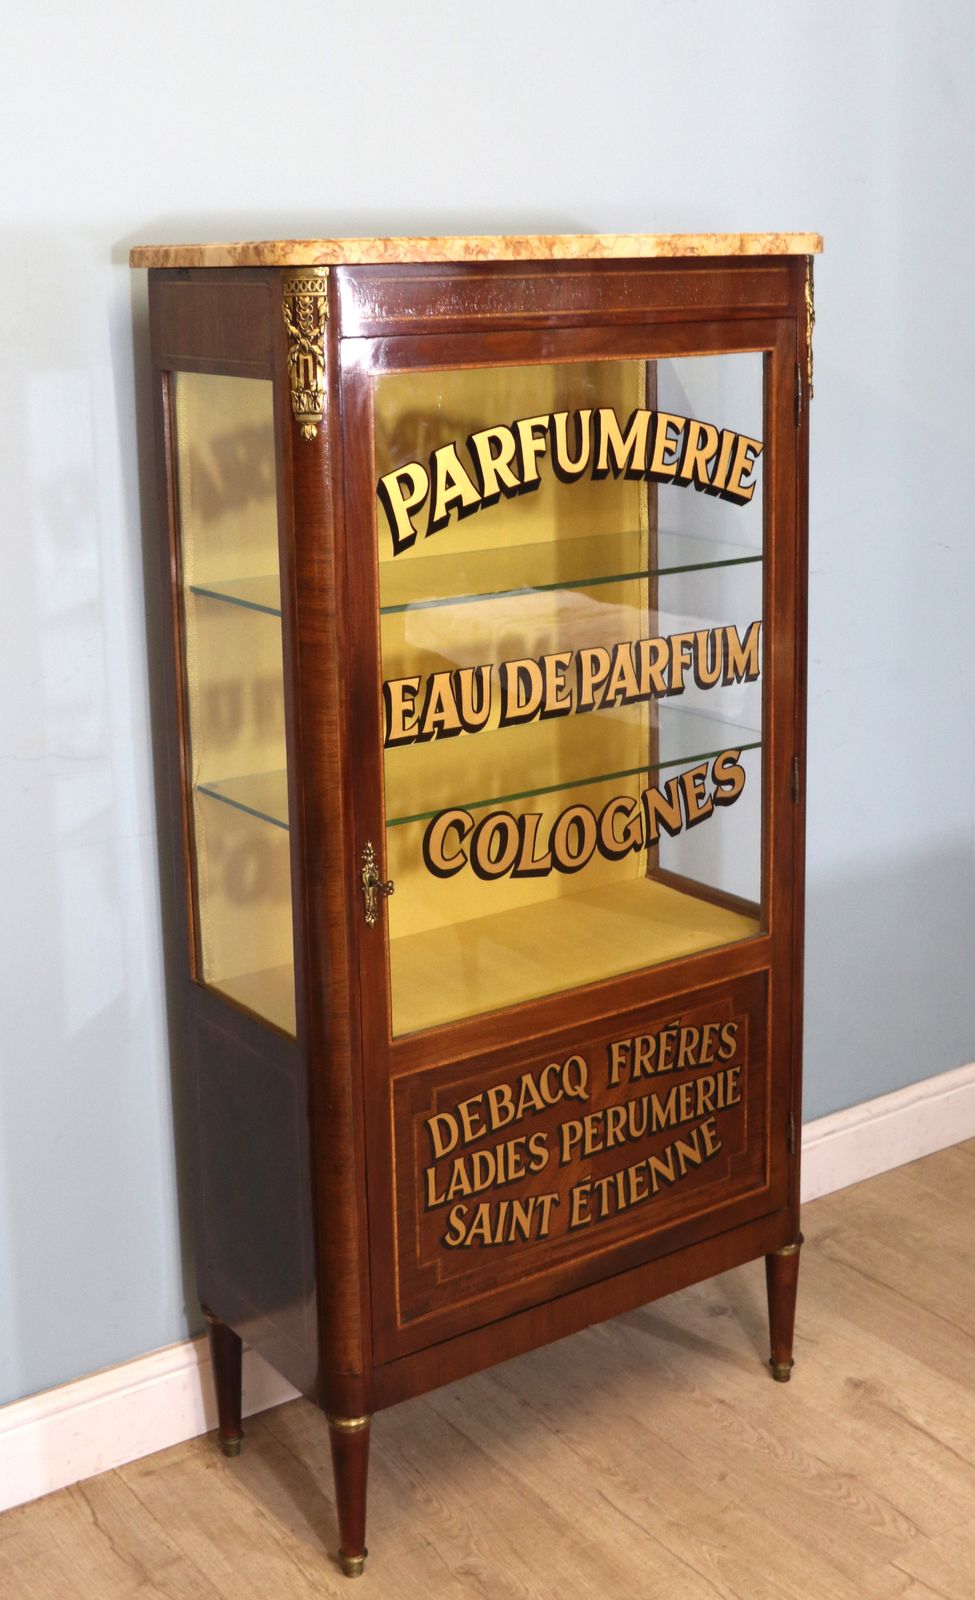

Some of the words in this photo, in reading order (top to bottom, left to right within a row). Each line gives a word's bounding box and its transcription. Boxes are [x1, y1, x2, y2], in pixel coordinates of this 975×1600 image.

[377, 408, 763, 556] PARFUMERIE
[383, 665, 493, 747] EAU
[499, 651, 573, 727] DE
[577, 621, 762, 709] PARFUM
[423, 748, 747, 879] COLOGNES
[425, 1131, 549, 1210] LADIES
[560, 1065, 742, 1164] PERUMERIE
[427, 1055, 590, 1161] DEBACQ
[443, 1192, 560, 1248] SAINT
[569, 1115, 723, 1230] ÉTIENNE
